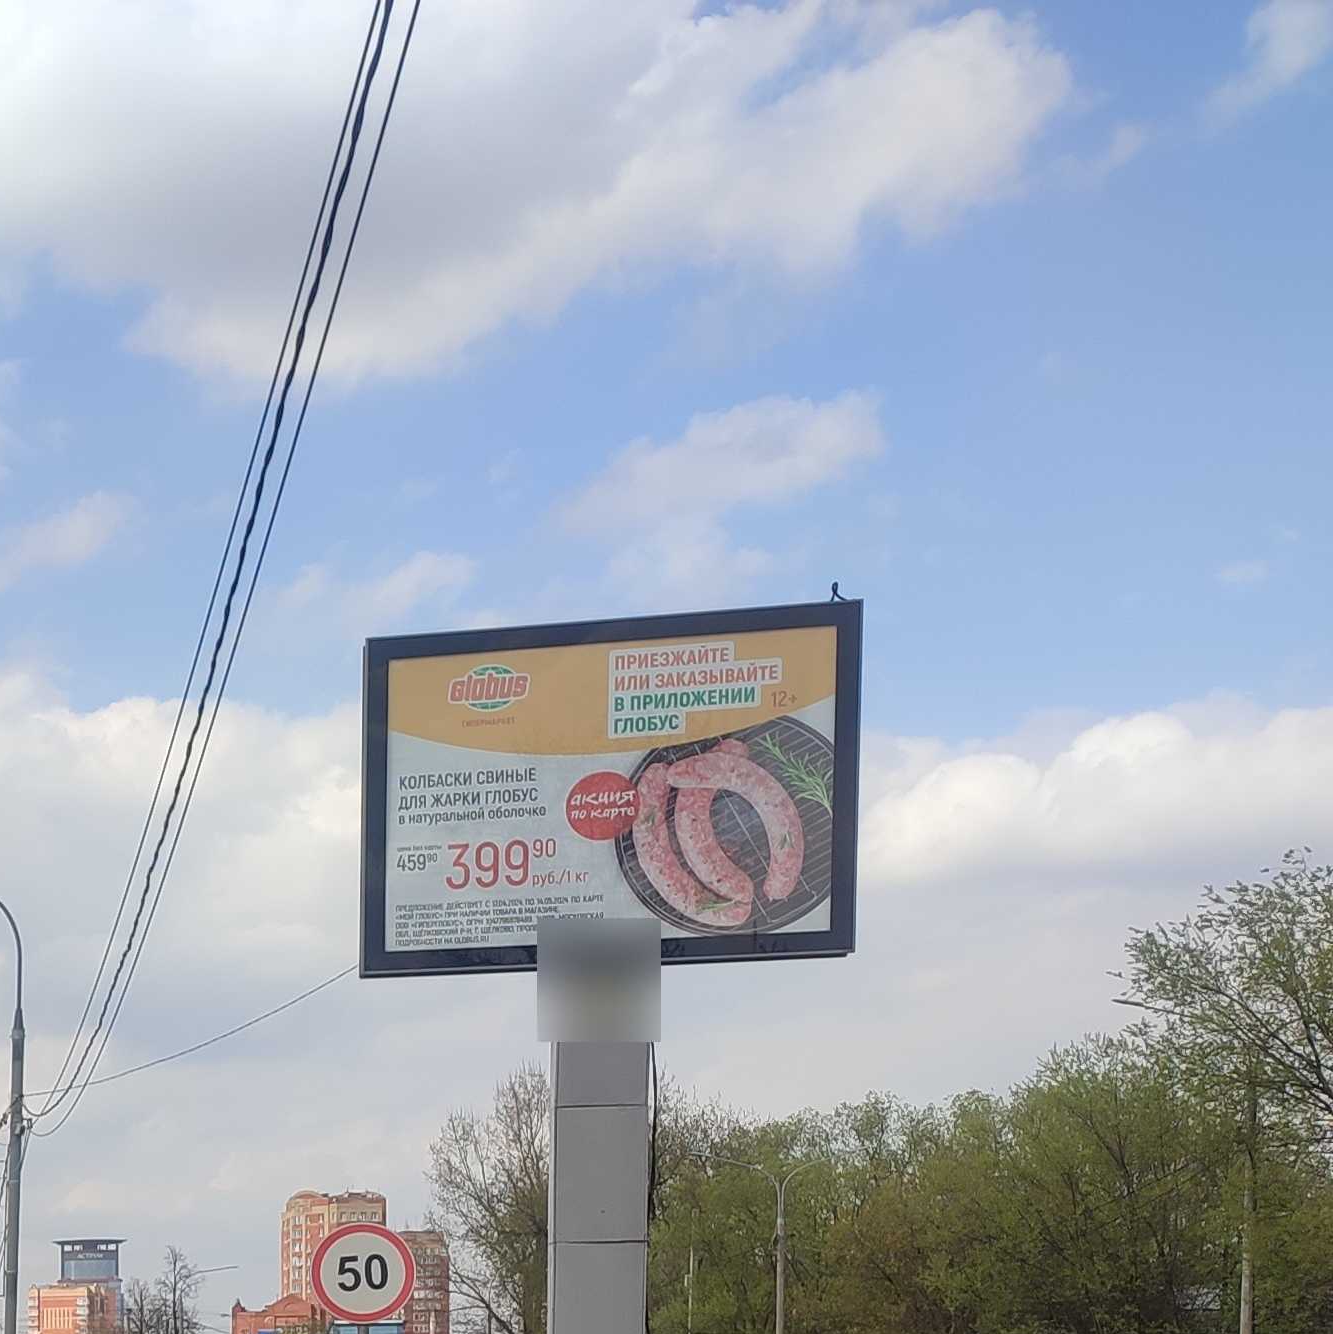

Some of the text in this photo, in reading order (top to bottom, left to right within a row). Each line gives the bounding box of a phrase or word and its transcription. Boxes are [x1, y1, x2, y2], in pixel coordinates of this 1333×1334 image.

[614, 646, 730, 671] ПРИЕЗЖАЙТЕ
[614, 663, 779, 692] ИЛИ ЗАКАЗЫВАЙТЕ
[614, 686, 756, 712] В ПРИЛОЖЕНИИ
[771, 690, 798, 708] 12+
[613, 714, 680, 735] ГЛОБУС
[398, 767, 537, 791] КОЛБАСКИ СВИНЫЕ
[398, 787, 539, 812] ДЛЯ ЖАРКИ ГЛОБУС
[408, 808, 485, 826] натуральной
[488, 805, 547, 820] оболочке
[445, 838, 557, 890] 399 90
[337, 1253, 389, 1292] 50
